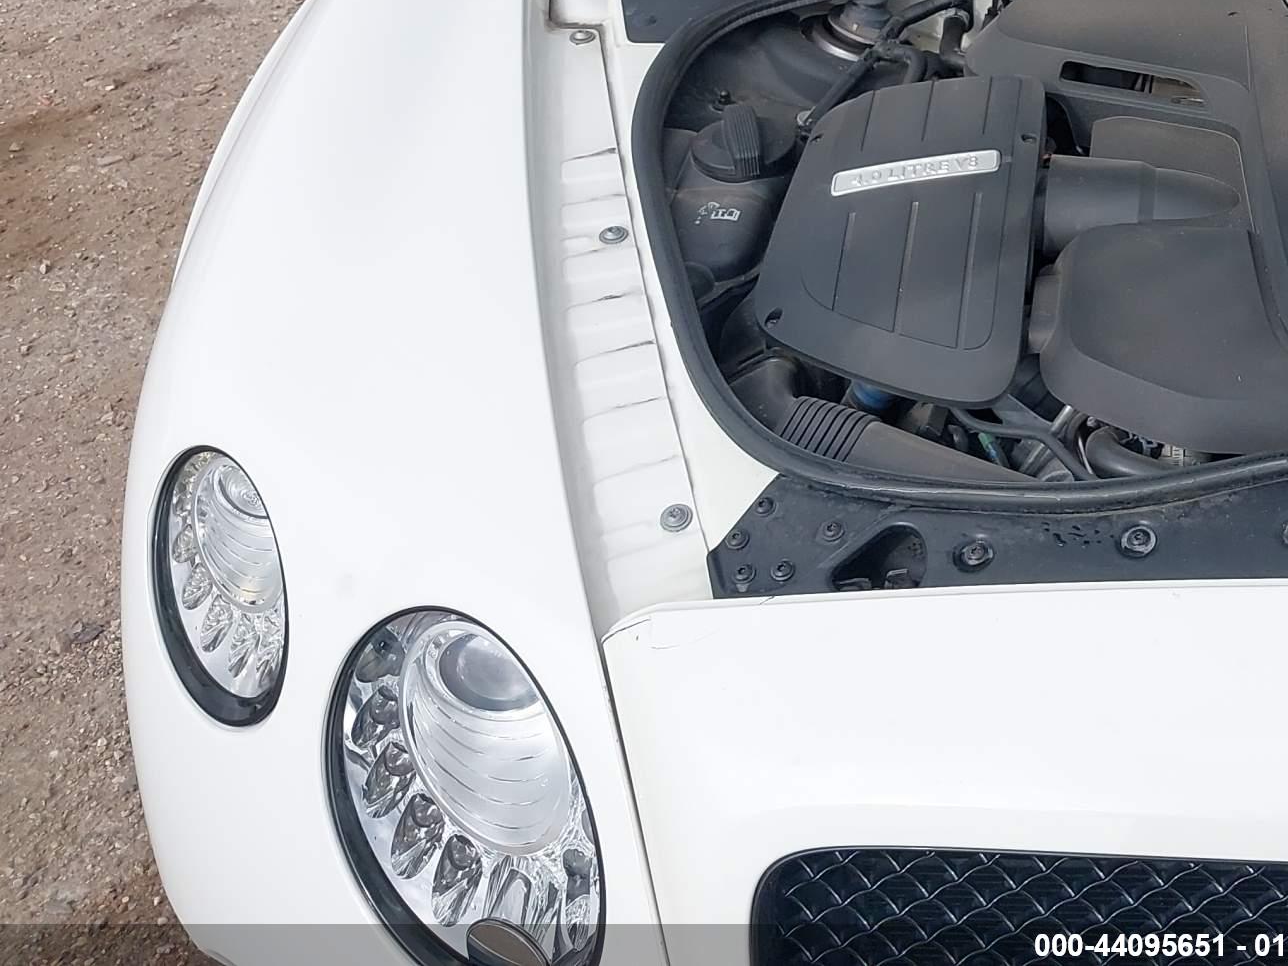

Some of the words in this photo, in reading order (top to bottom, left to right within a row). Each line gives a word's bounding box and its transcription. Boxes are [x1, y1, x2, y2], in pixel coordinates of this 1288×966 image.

[850, 171, 883, 186] 4.0
[888, 159, 949, 180] LITRE
[955, 154, 979, 170] V8
